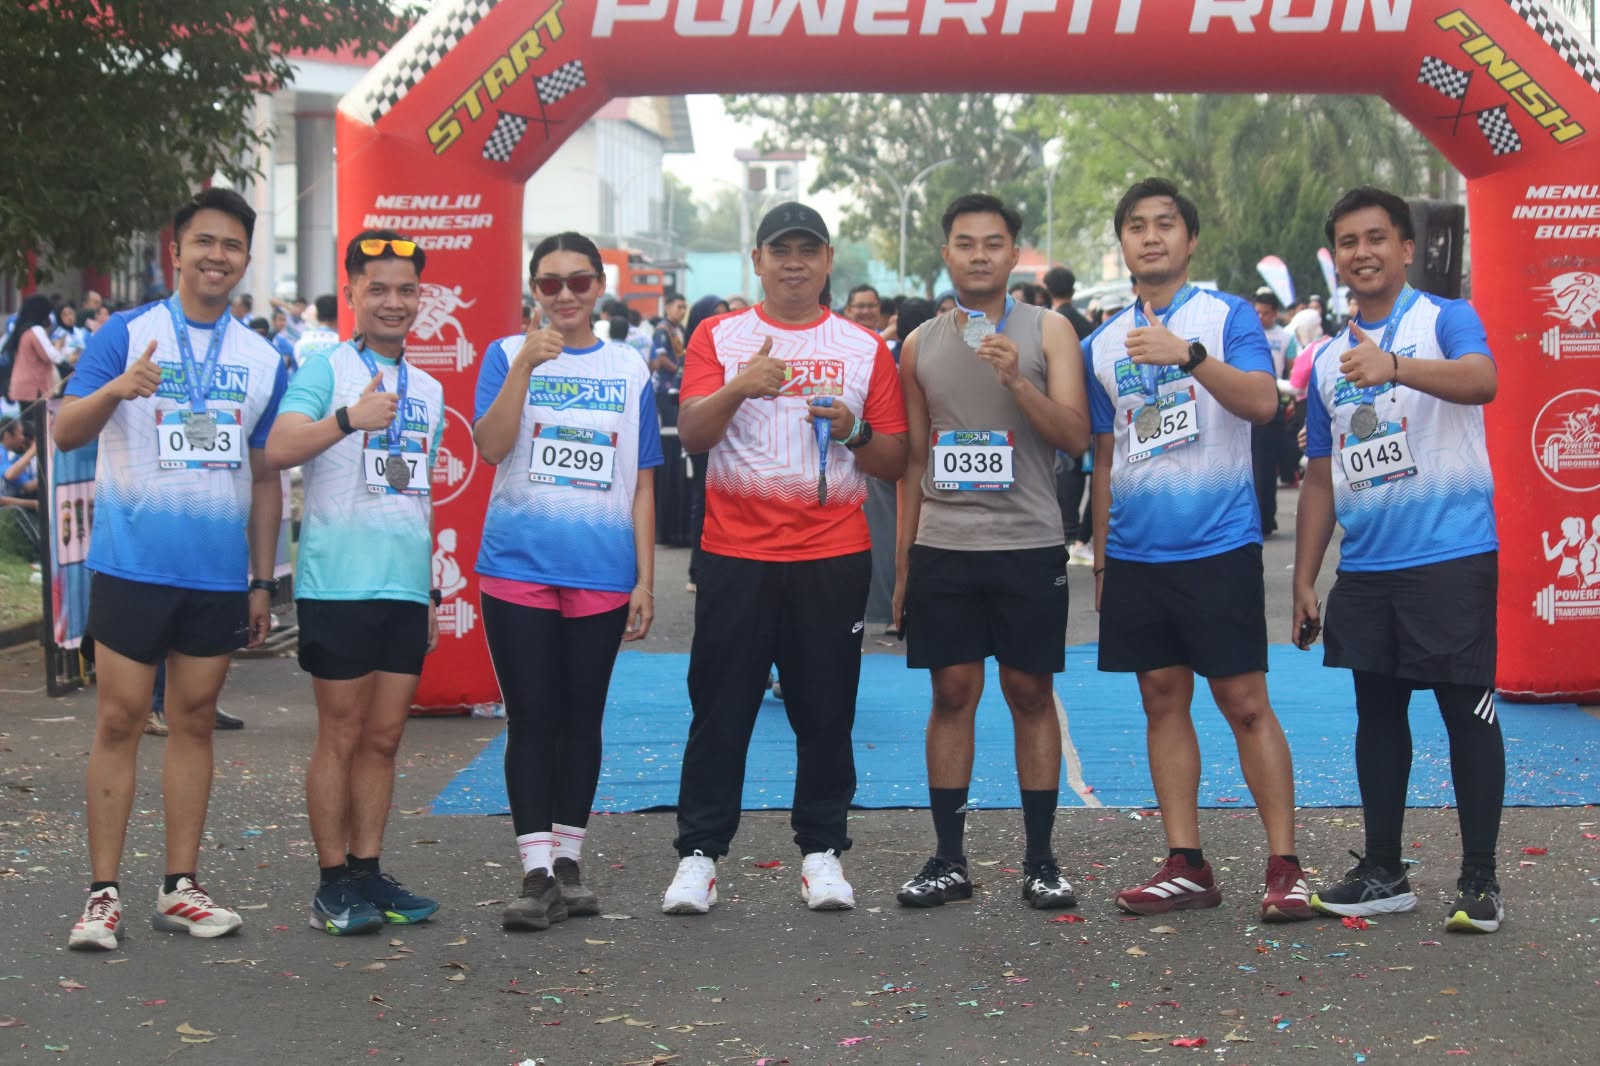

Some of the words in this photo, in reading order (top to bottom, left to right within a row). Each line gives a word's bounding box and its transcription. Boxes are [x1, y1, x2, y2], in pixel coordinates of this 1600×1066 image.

[591, 0, 1143, 37] POWERFIT
[1189, 0, 1411, 34] RUN
[425, 0, 565, 155] START
[1434, 9, 1586, 143] FINISH
[375, 194, 481, 210] MENUJU
[1525, 184, 1600, 199] MENU
[362, 214, 494, 230] INDONESIA
[411, 235, 473, 249] UGAR
[529, 381, 579, 396] FUN
[169, 431, 231, 451] 03
[542, 446, 604, 471] 0299
[943, 452, 1003, 473] 0338
[1350, 441, 1403, 472] 0143
[375, 456, 418, 479] 07
